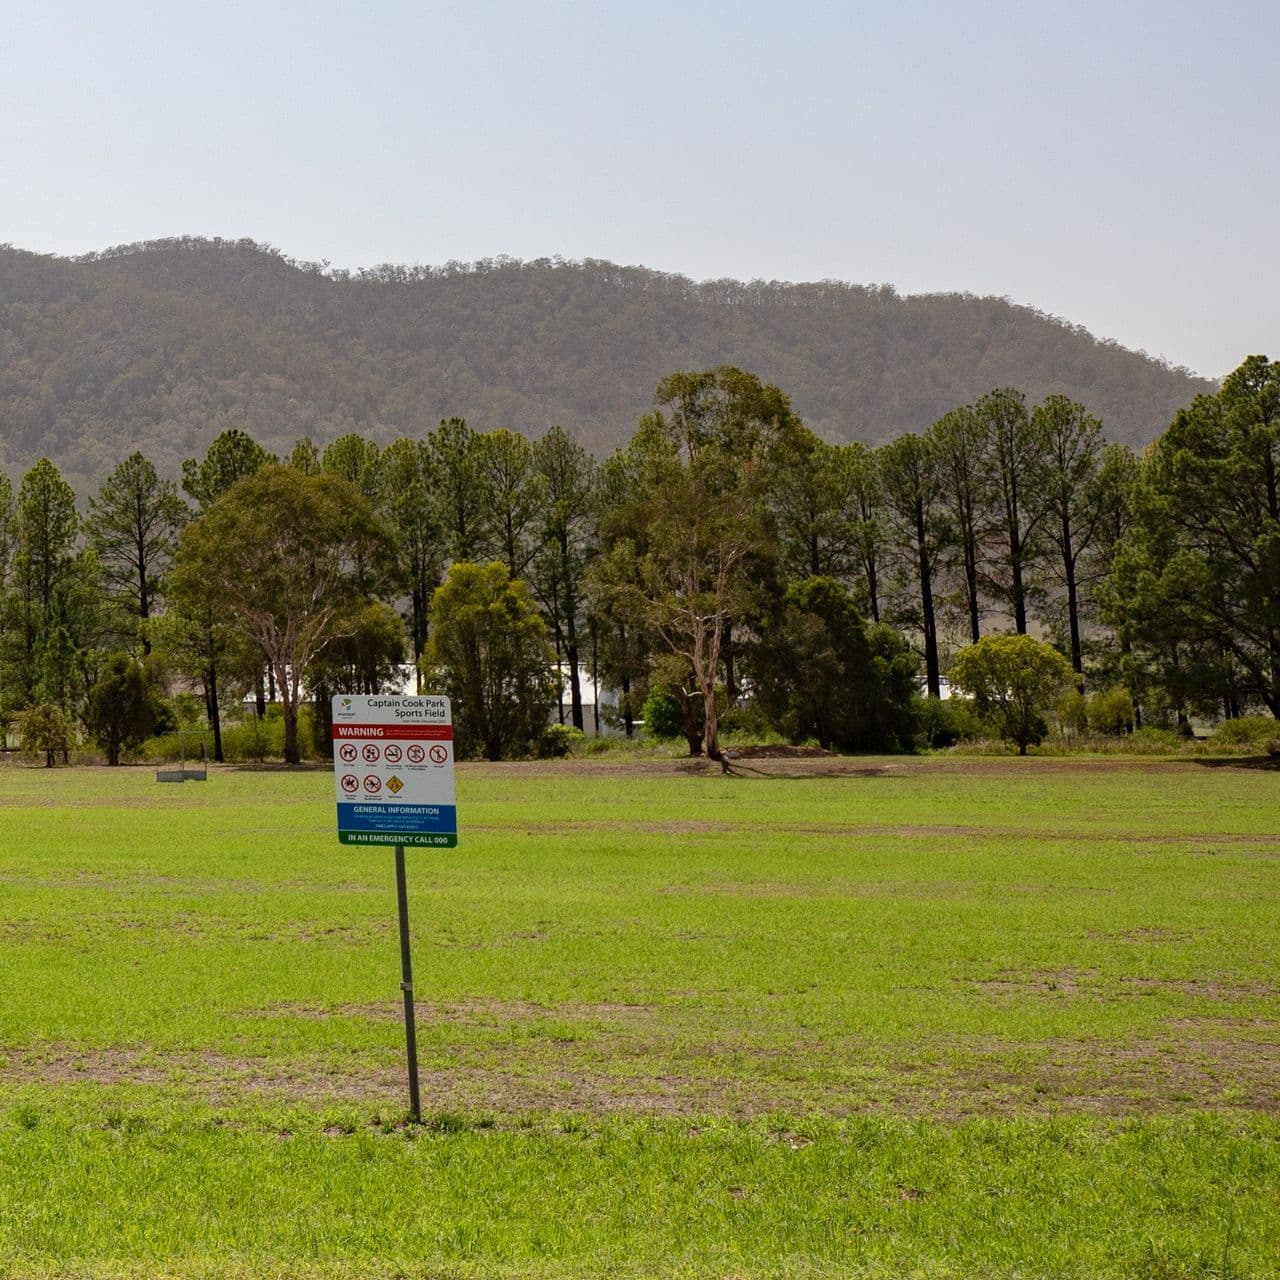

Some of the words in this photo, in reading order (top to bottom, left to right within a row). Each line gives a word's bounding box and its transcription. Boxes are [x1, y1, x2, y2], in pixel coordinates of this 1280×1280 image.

[367, 699, 400, 709] Captain
[402, 699, 424, 708] Cook
[426, 700, 445, 708] Park
[395, 709, 422, 719] Sports
[424, 709, 445, 718] Field
[338, 727, 384, 736] WARNING
[353, 806, 387, 814] GENERAL
[387, 807, 440, 815] INFORMATION
[369, 835, 413, 843] EMERGENCY
